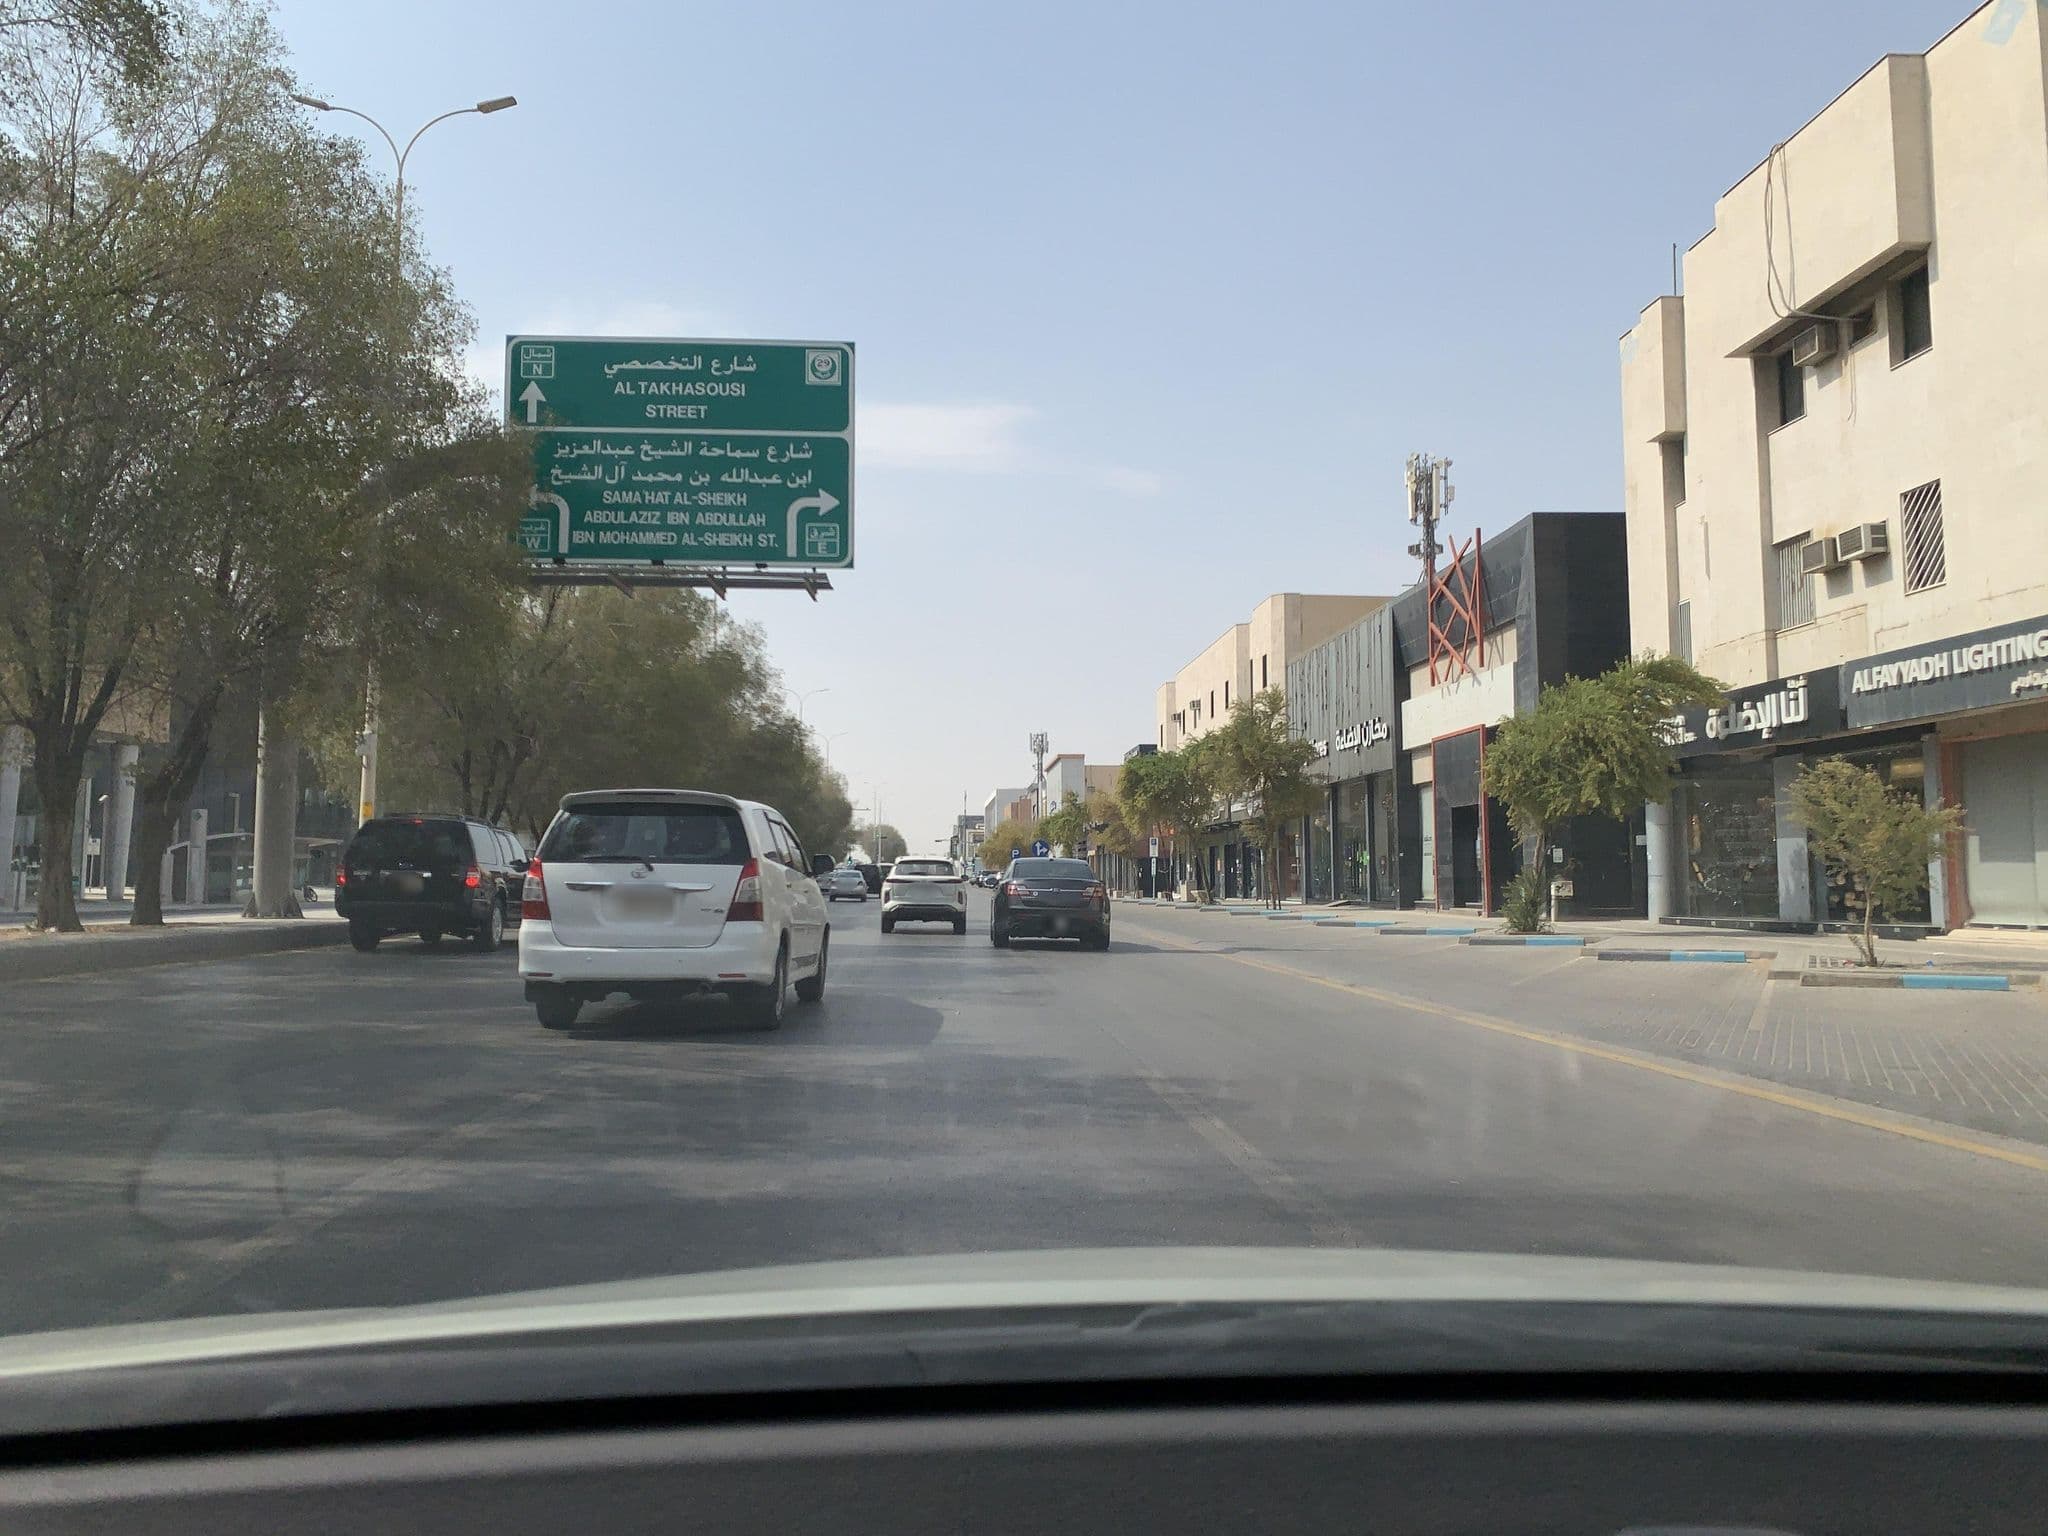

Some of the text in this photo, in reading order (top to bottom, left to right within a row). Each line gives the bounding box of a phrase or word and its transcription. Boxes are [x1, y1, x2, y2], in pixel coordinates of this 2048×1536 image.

[523, 348, 552, 359] شمال
[532, 363, 543, 375] N
[604, 355, 757, 378] شارع التخصصي
[614, 381, 746, 397] AL TAKHASOUSI
[645, 404, 708, 419] STREET
[554, 439, 813, 463] شارع سماحة الشيخ عبدالعزيز
[550, 461, 813, 488] ابن عبدالله بن محمد آل الشيخ
[673, 491, 748, 507] AL-SHEIKH
[584, 510, 767, 527] ABDULAZIZ IBN ABDULLAH
[572, 530, 779, 548] IBN MOHAMMED AL-SHEIKH ST.
[809, 527, 836, 539] شرق
[526, 537, 541, 549] W
[818, 542, 828, 554] E
[1852, 629, 2048, 694] ALFAYYADH LIGHTING
[1706, 692, 1782, 740] الإضاءة
[1335, 723, 1361, 753] الإضاءة
[1361, 716, 1388, 747] مخازن
